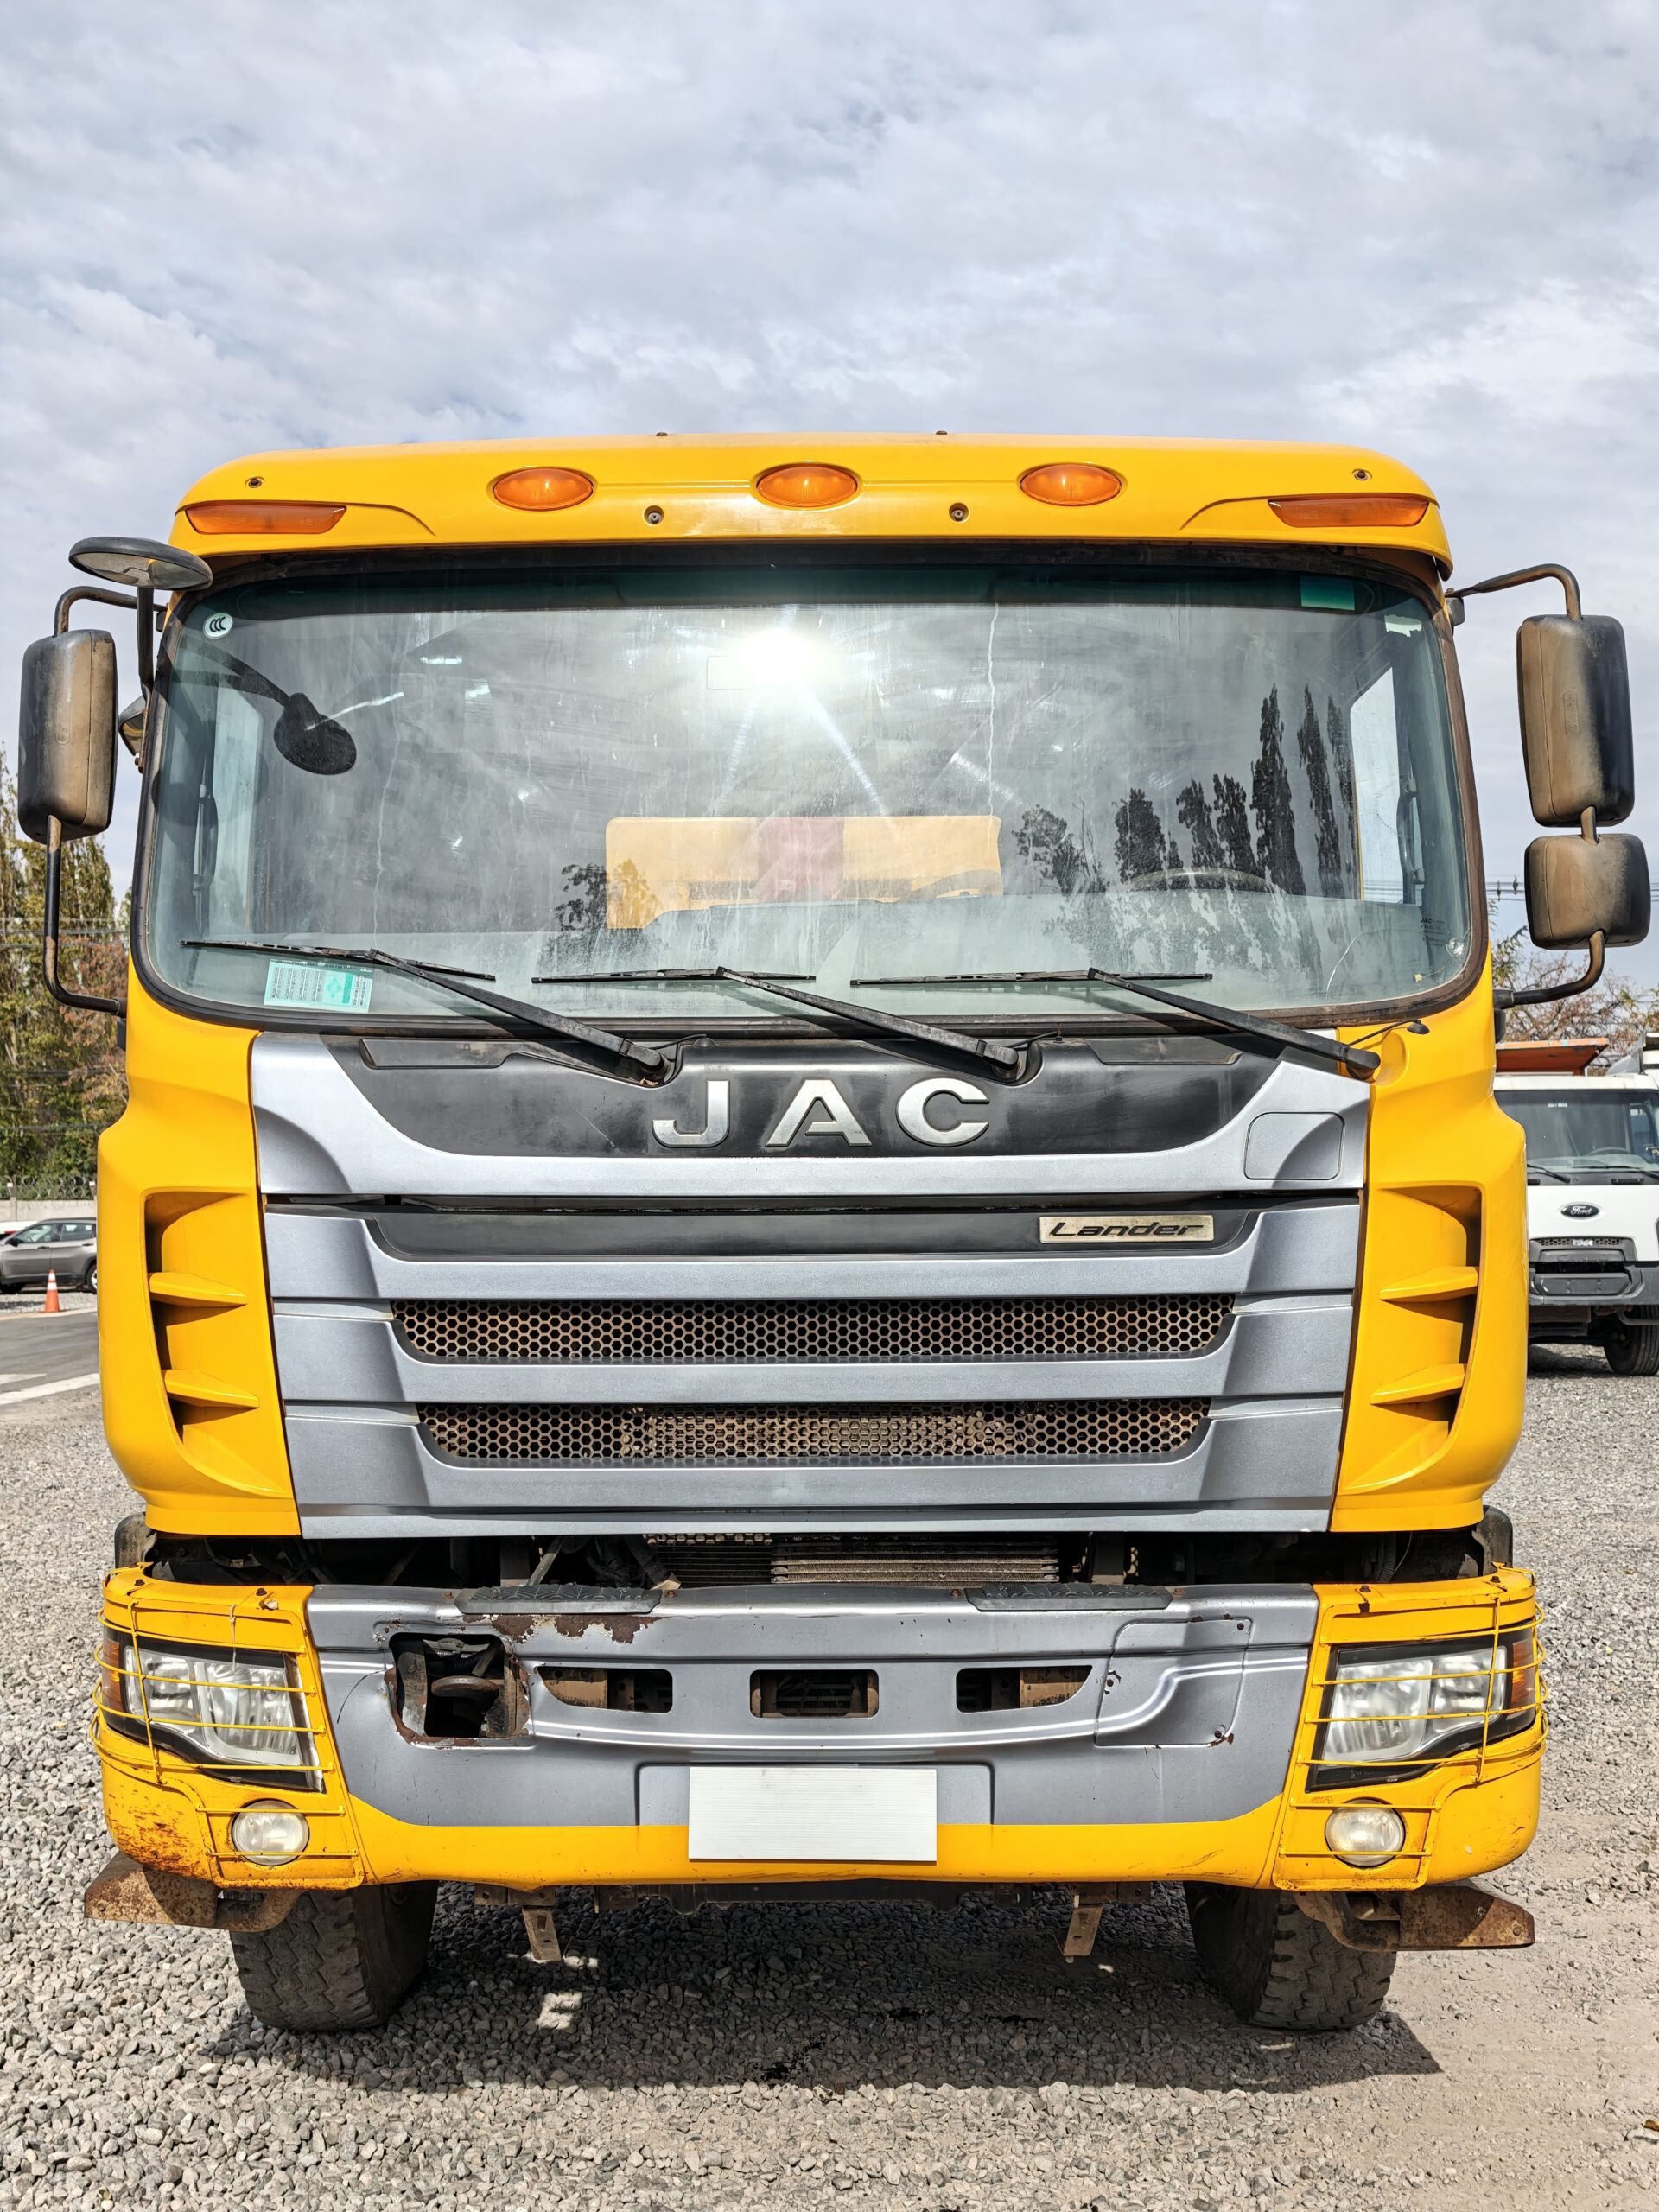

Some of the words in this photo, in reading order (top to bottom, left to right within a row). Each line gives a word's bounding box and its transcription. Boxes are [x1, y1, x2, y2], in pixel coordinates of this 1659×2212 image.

[652, 1077, 990, 1147] JAC
[1570, 1205, 1593, 1216] Ford
[1050, 1222, 1205, 1237] Lander
